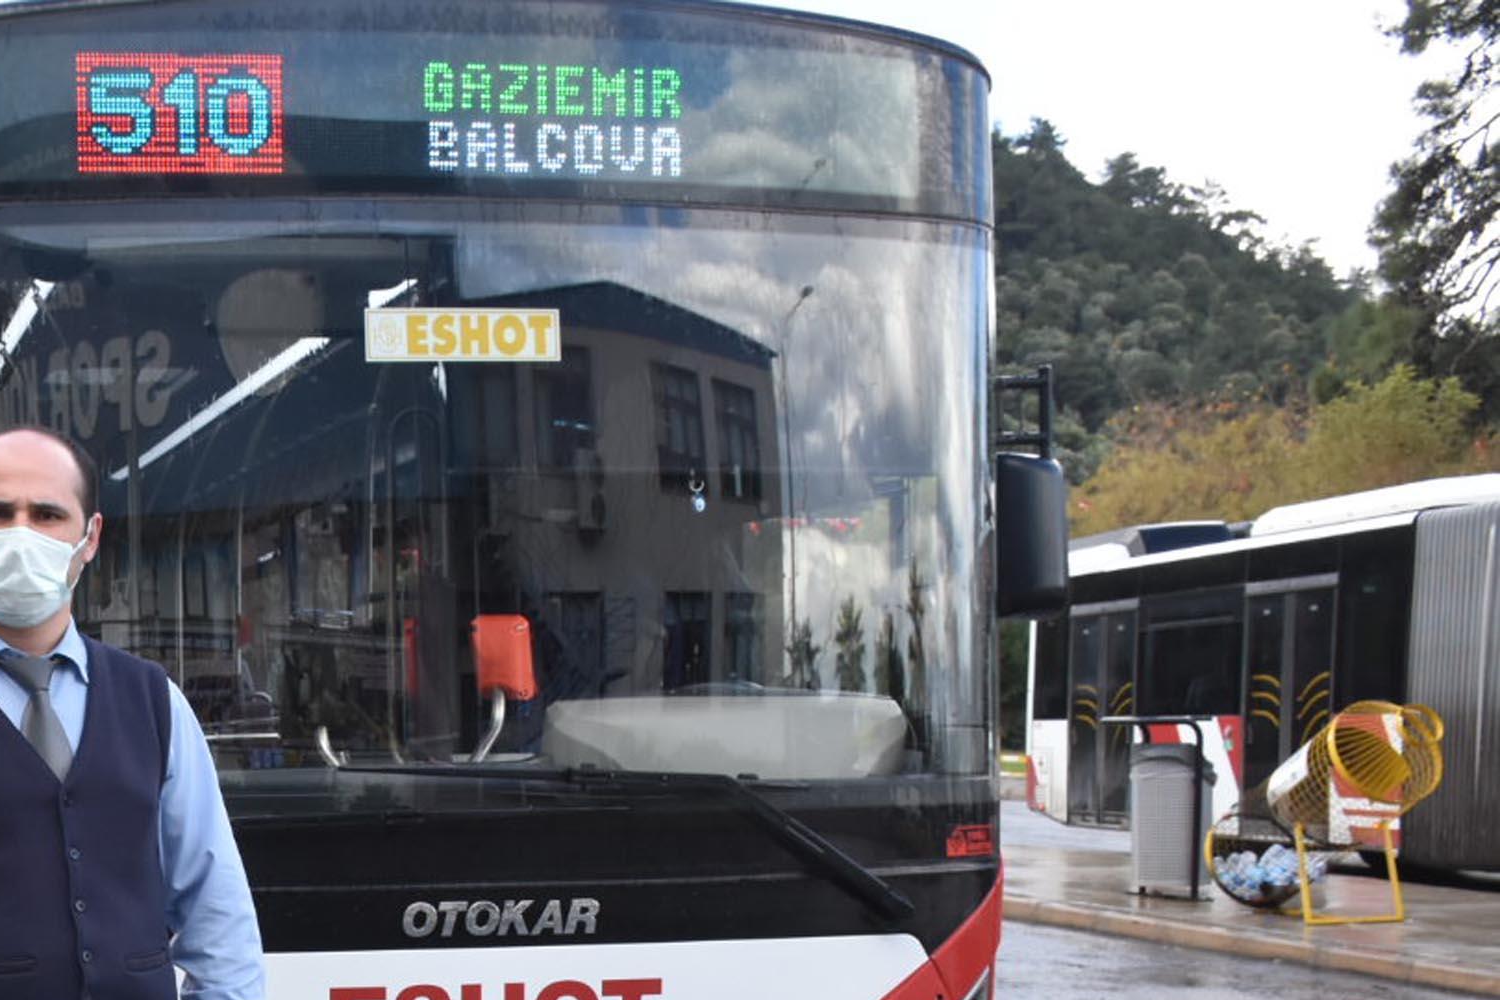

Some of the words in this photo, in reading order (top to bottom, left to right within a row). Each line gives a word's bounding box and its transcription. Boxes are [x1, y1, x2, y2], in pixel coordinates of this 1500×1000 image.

[90, 72, 268, 155] 510
[406, 313, 554, 356] ESHOT
[402, 898, 600, 938] OTOKAR
